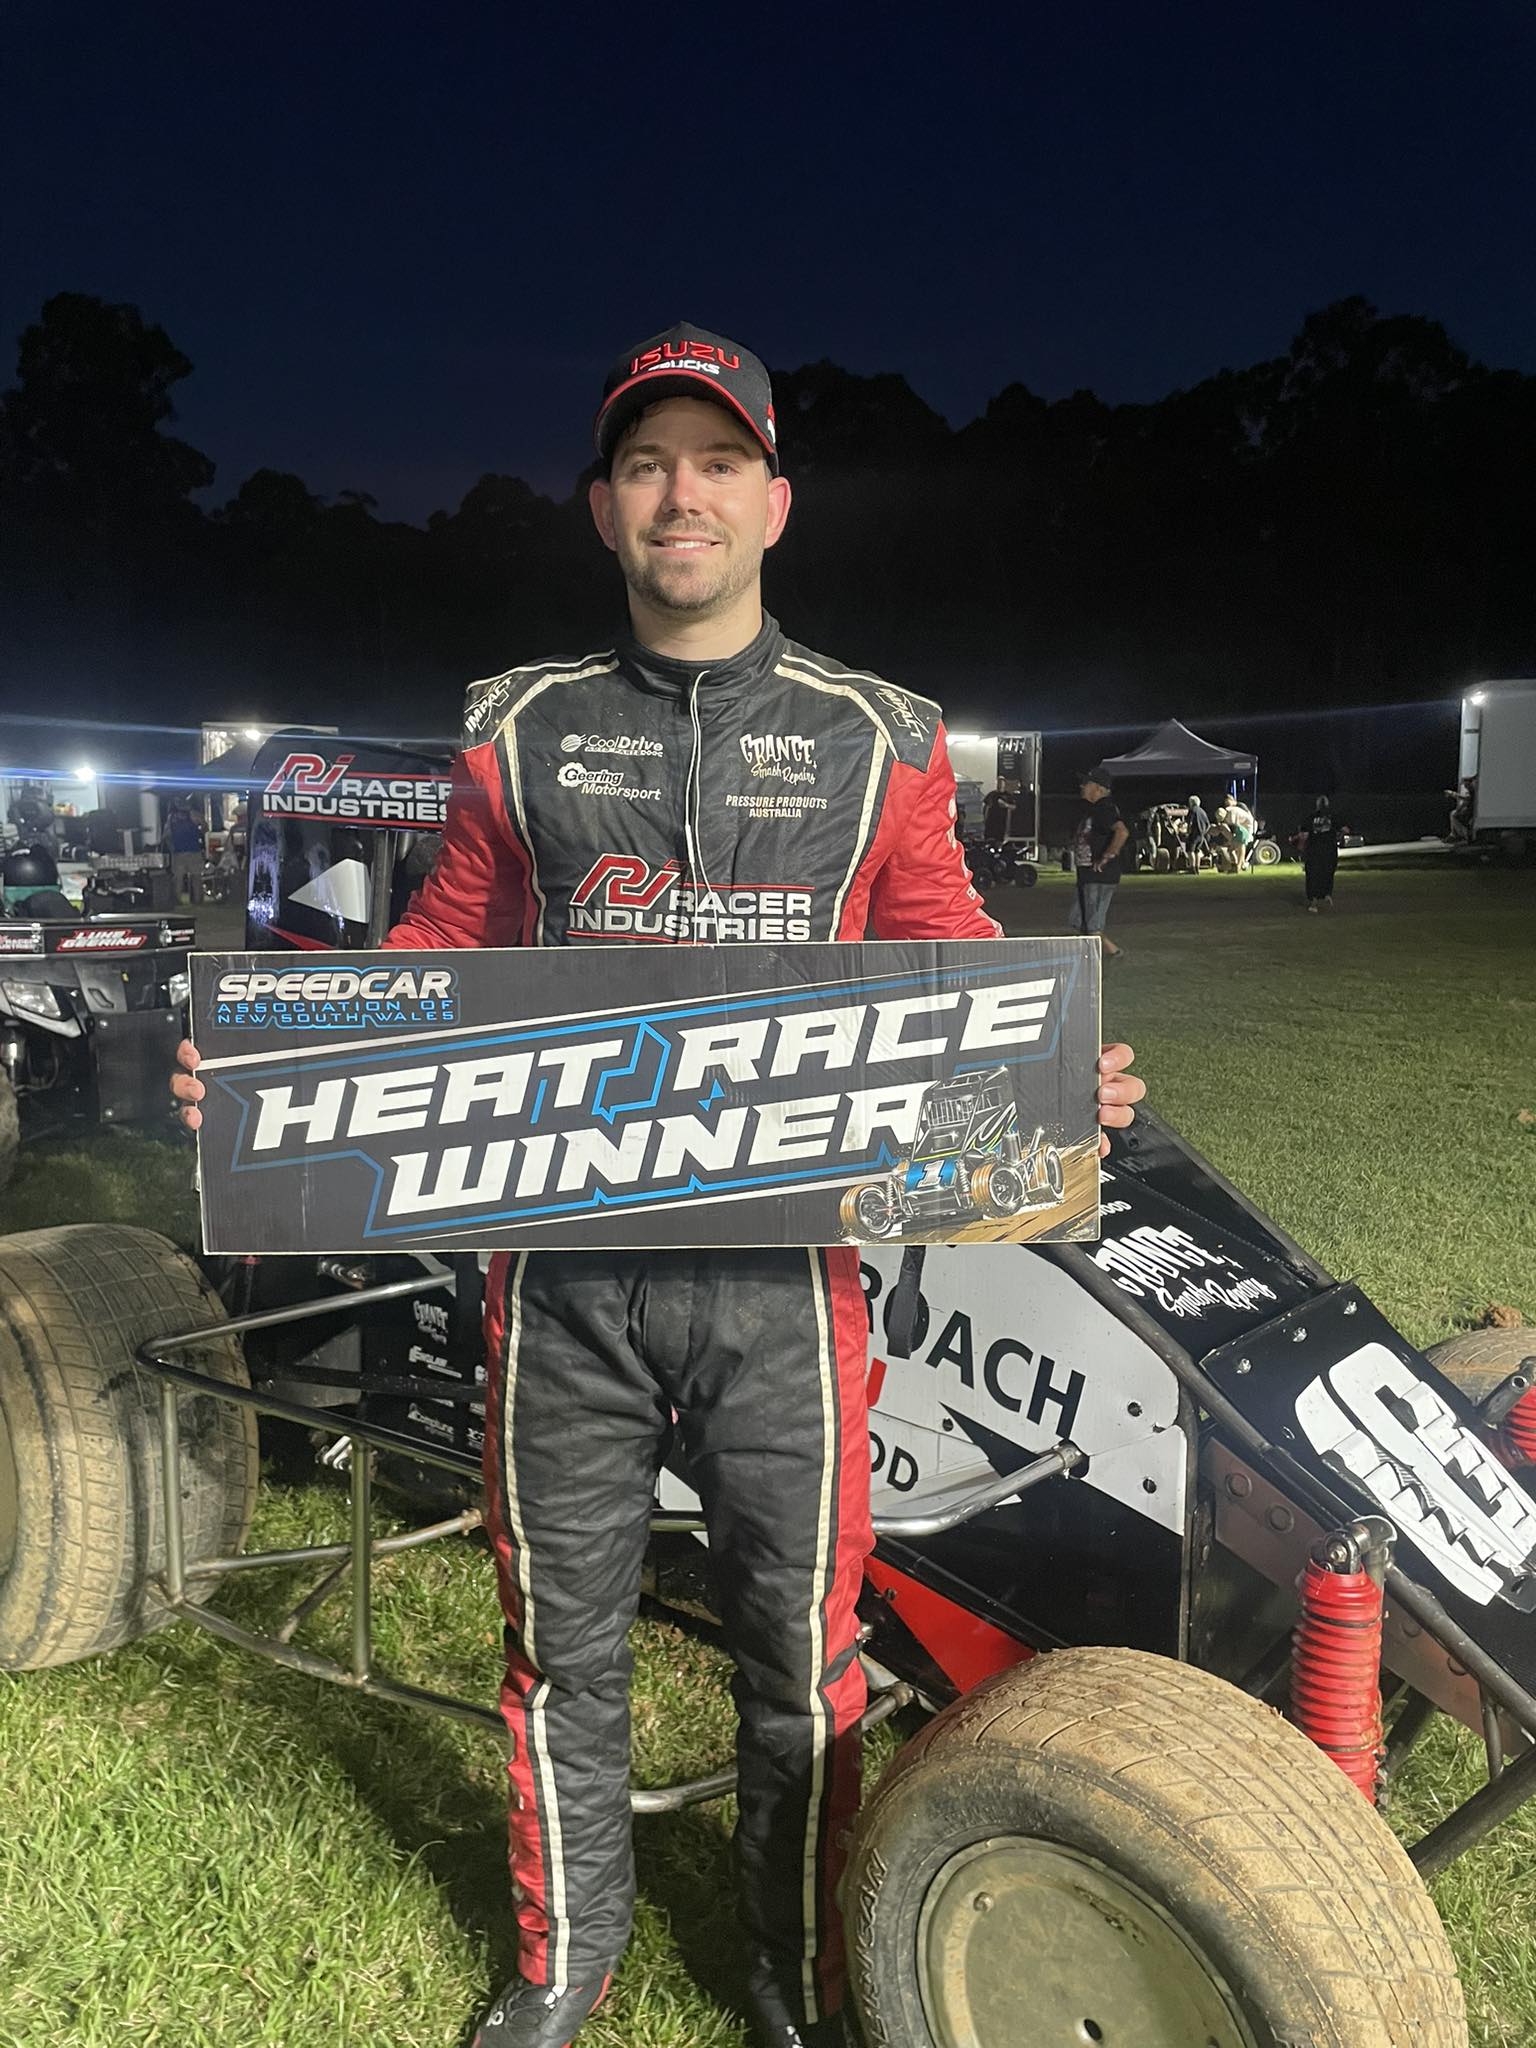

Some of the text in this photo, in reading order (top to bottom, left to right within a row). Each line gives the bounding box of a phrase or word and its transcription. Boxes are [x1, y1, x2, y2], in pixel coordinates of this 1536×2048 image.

[631, 340, 739, 374] ISUZU
[464, 676, 513, 733] IMPACT
[587, 734, 664, 752] CoolDrive
[565, 767, 623, 785] Geering
[750, 763, 782, 780] Smash
[581, 782, 662, 800] Motorsport
[725, 794, 828, 810] PRESSURE PRODUCTS
[749, 807, 802, 818] AUSTRALIA
[669, 889, 812, 915] RACER
[569, 907, 811, 941] INDUSTRIES
[216, 971, 452, 1002] SPEEDCAR
[217, 1000, 454, 1014] ASSOCIATION OF
[217, 1010, 455, 1024] NEW SOUTH WALES
[253, 977, 1056, 1151] HEAT RACE
[386, 1080, 926, 1216] WINNER
